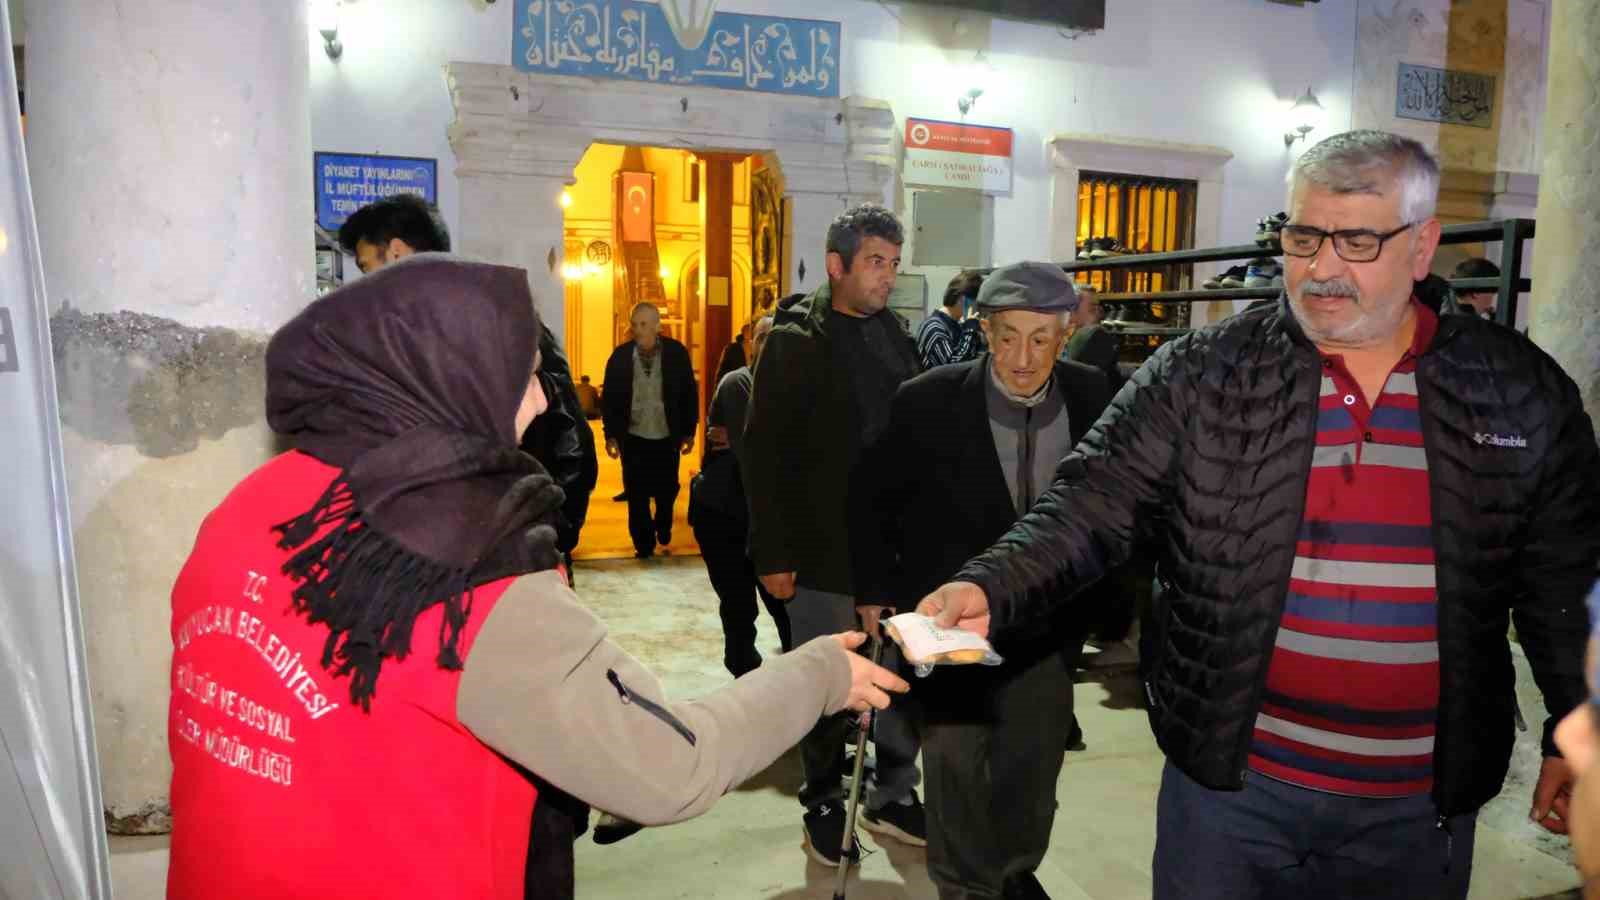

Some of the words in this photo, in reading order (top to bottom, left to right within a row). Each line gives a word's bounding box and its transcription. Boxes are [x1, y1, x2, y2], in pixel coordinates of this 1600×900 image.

[324, 162, 359, 178] DİYANET
[1483, 433, 1527, 448] Columbia
[237, 610, 339, 720] BELEDİYESİ
[220, 686, 238, 717] VE
[238, 696, 296, 743] SOSYAL
[204, 726, 293, 787] MÜDÜRLÜĞÜ
